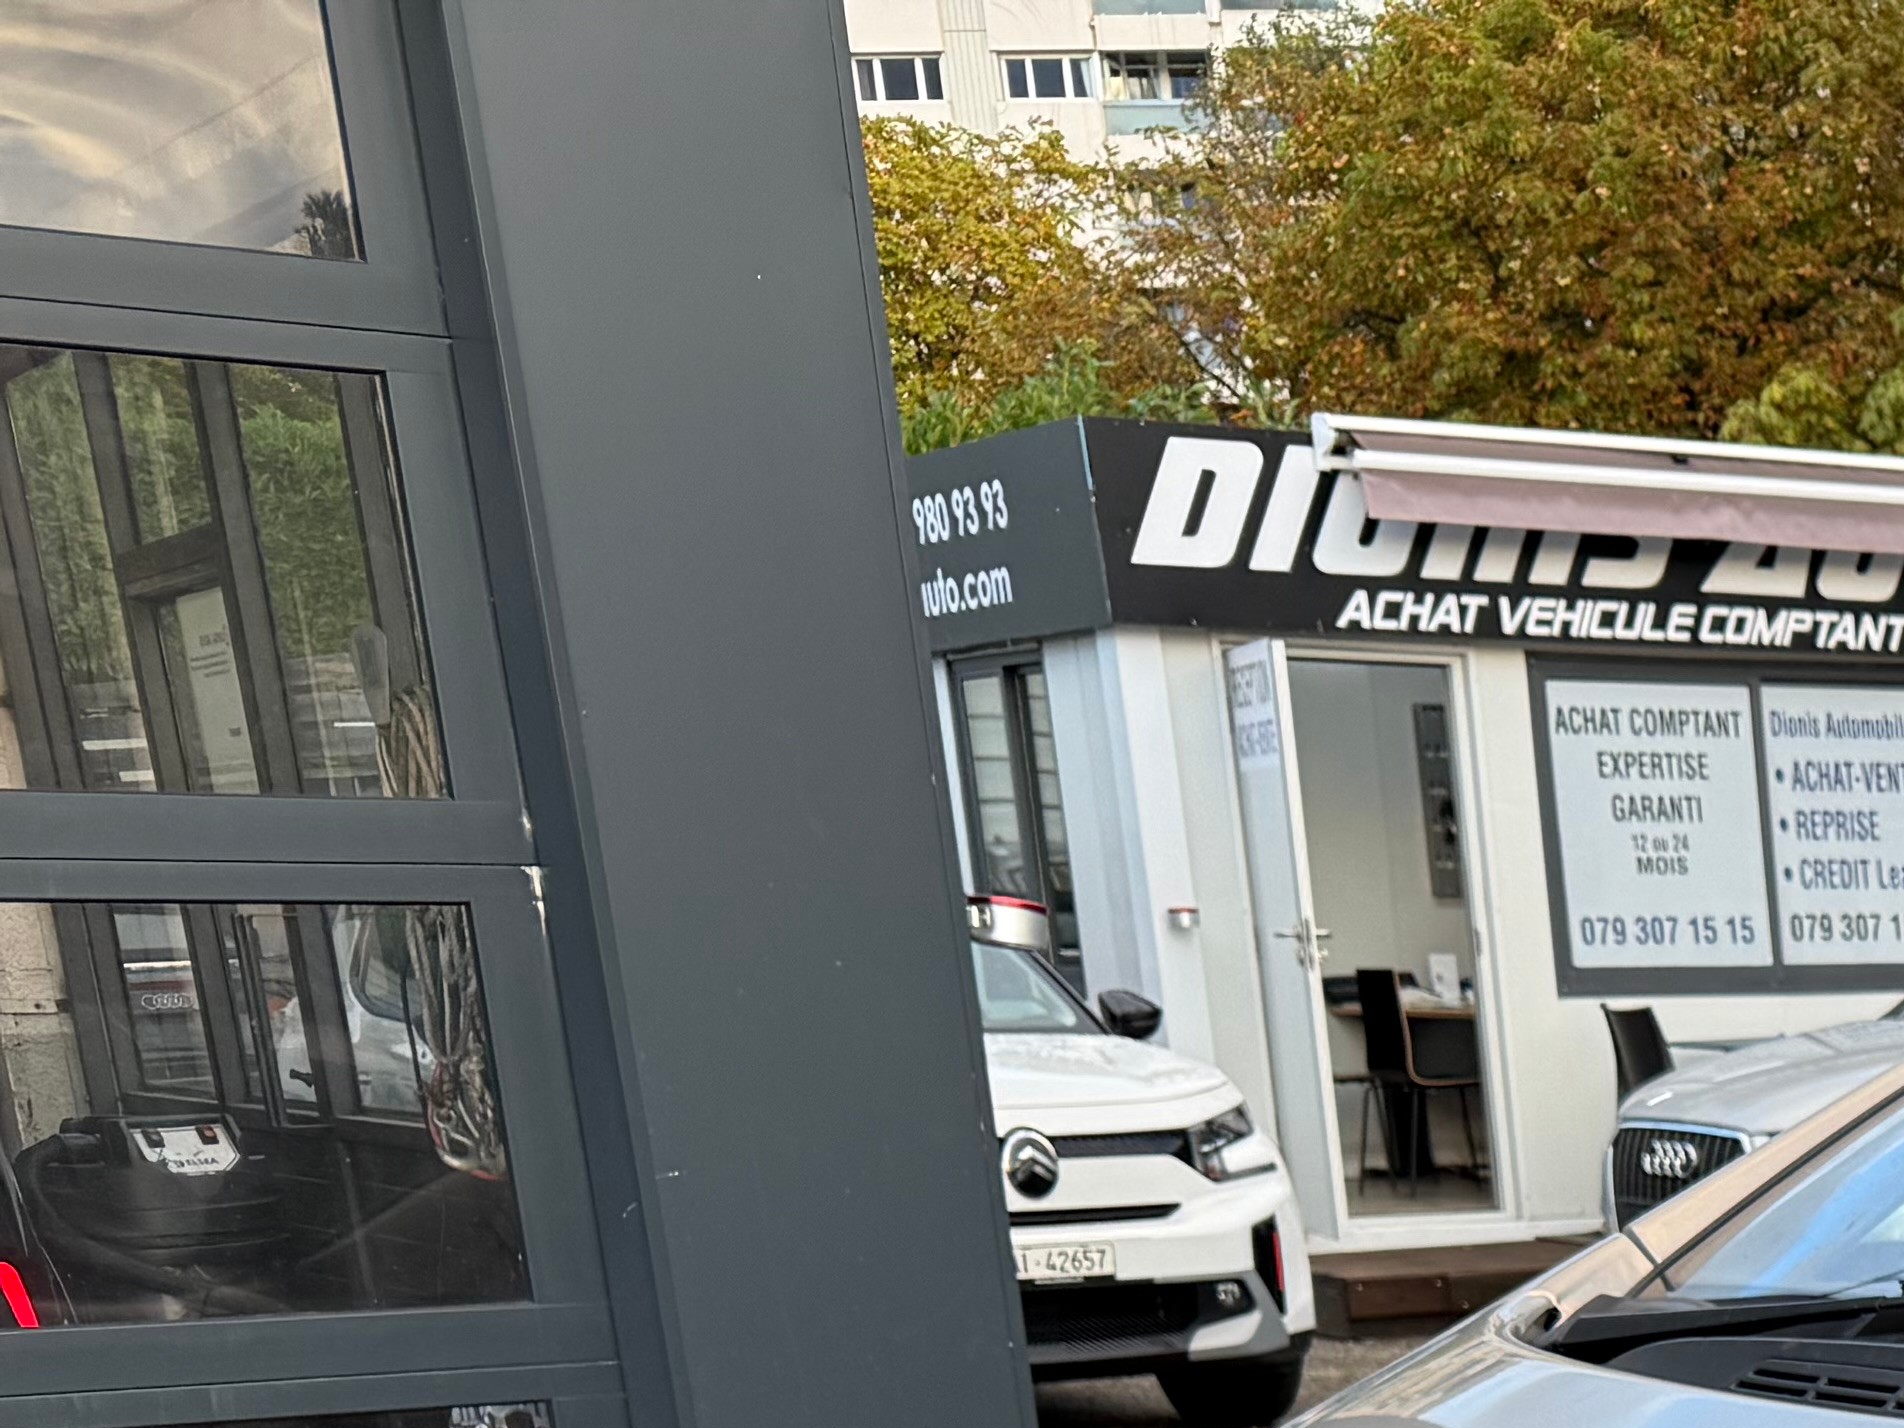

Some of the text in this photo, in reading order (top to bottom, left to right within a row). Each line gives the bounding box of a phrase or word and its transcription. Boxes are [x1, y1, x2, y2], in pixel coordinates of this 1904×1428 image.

[912, 478, 1009, 545] 980 93 93
[1334, 588, 1490, 634] ACHAT
[1498, 596, 1698, 643] VEHICULE
[1555, 706, 1743, 738] ACHAT COMPTANT
[1770, 710, 1821, 739] Dionis
[1597, 751, 1710, 781] EXPERTISE
[1611, 794, 1704, 824] GARANTI
[1795, 810, 1881, 842] REPRISE
[1631, 834, 1690, 853] 12 ou 24
[1636, 857, 1689, 876] MOIS
[1799, 859, 1870, 891] CREDIT
[1581, 916, 1756, 946] 079 307 15 15
[1790, 914, 1834, 942] 079
[1840, 914, 1882, 942] 307
